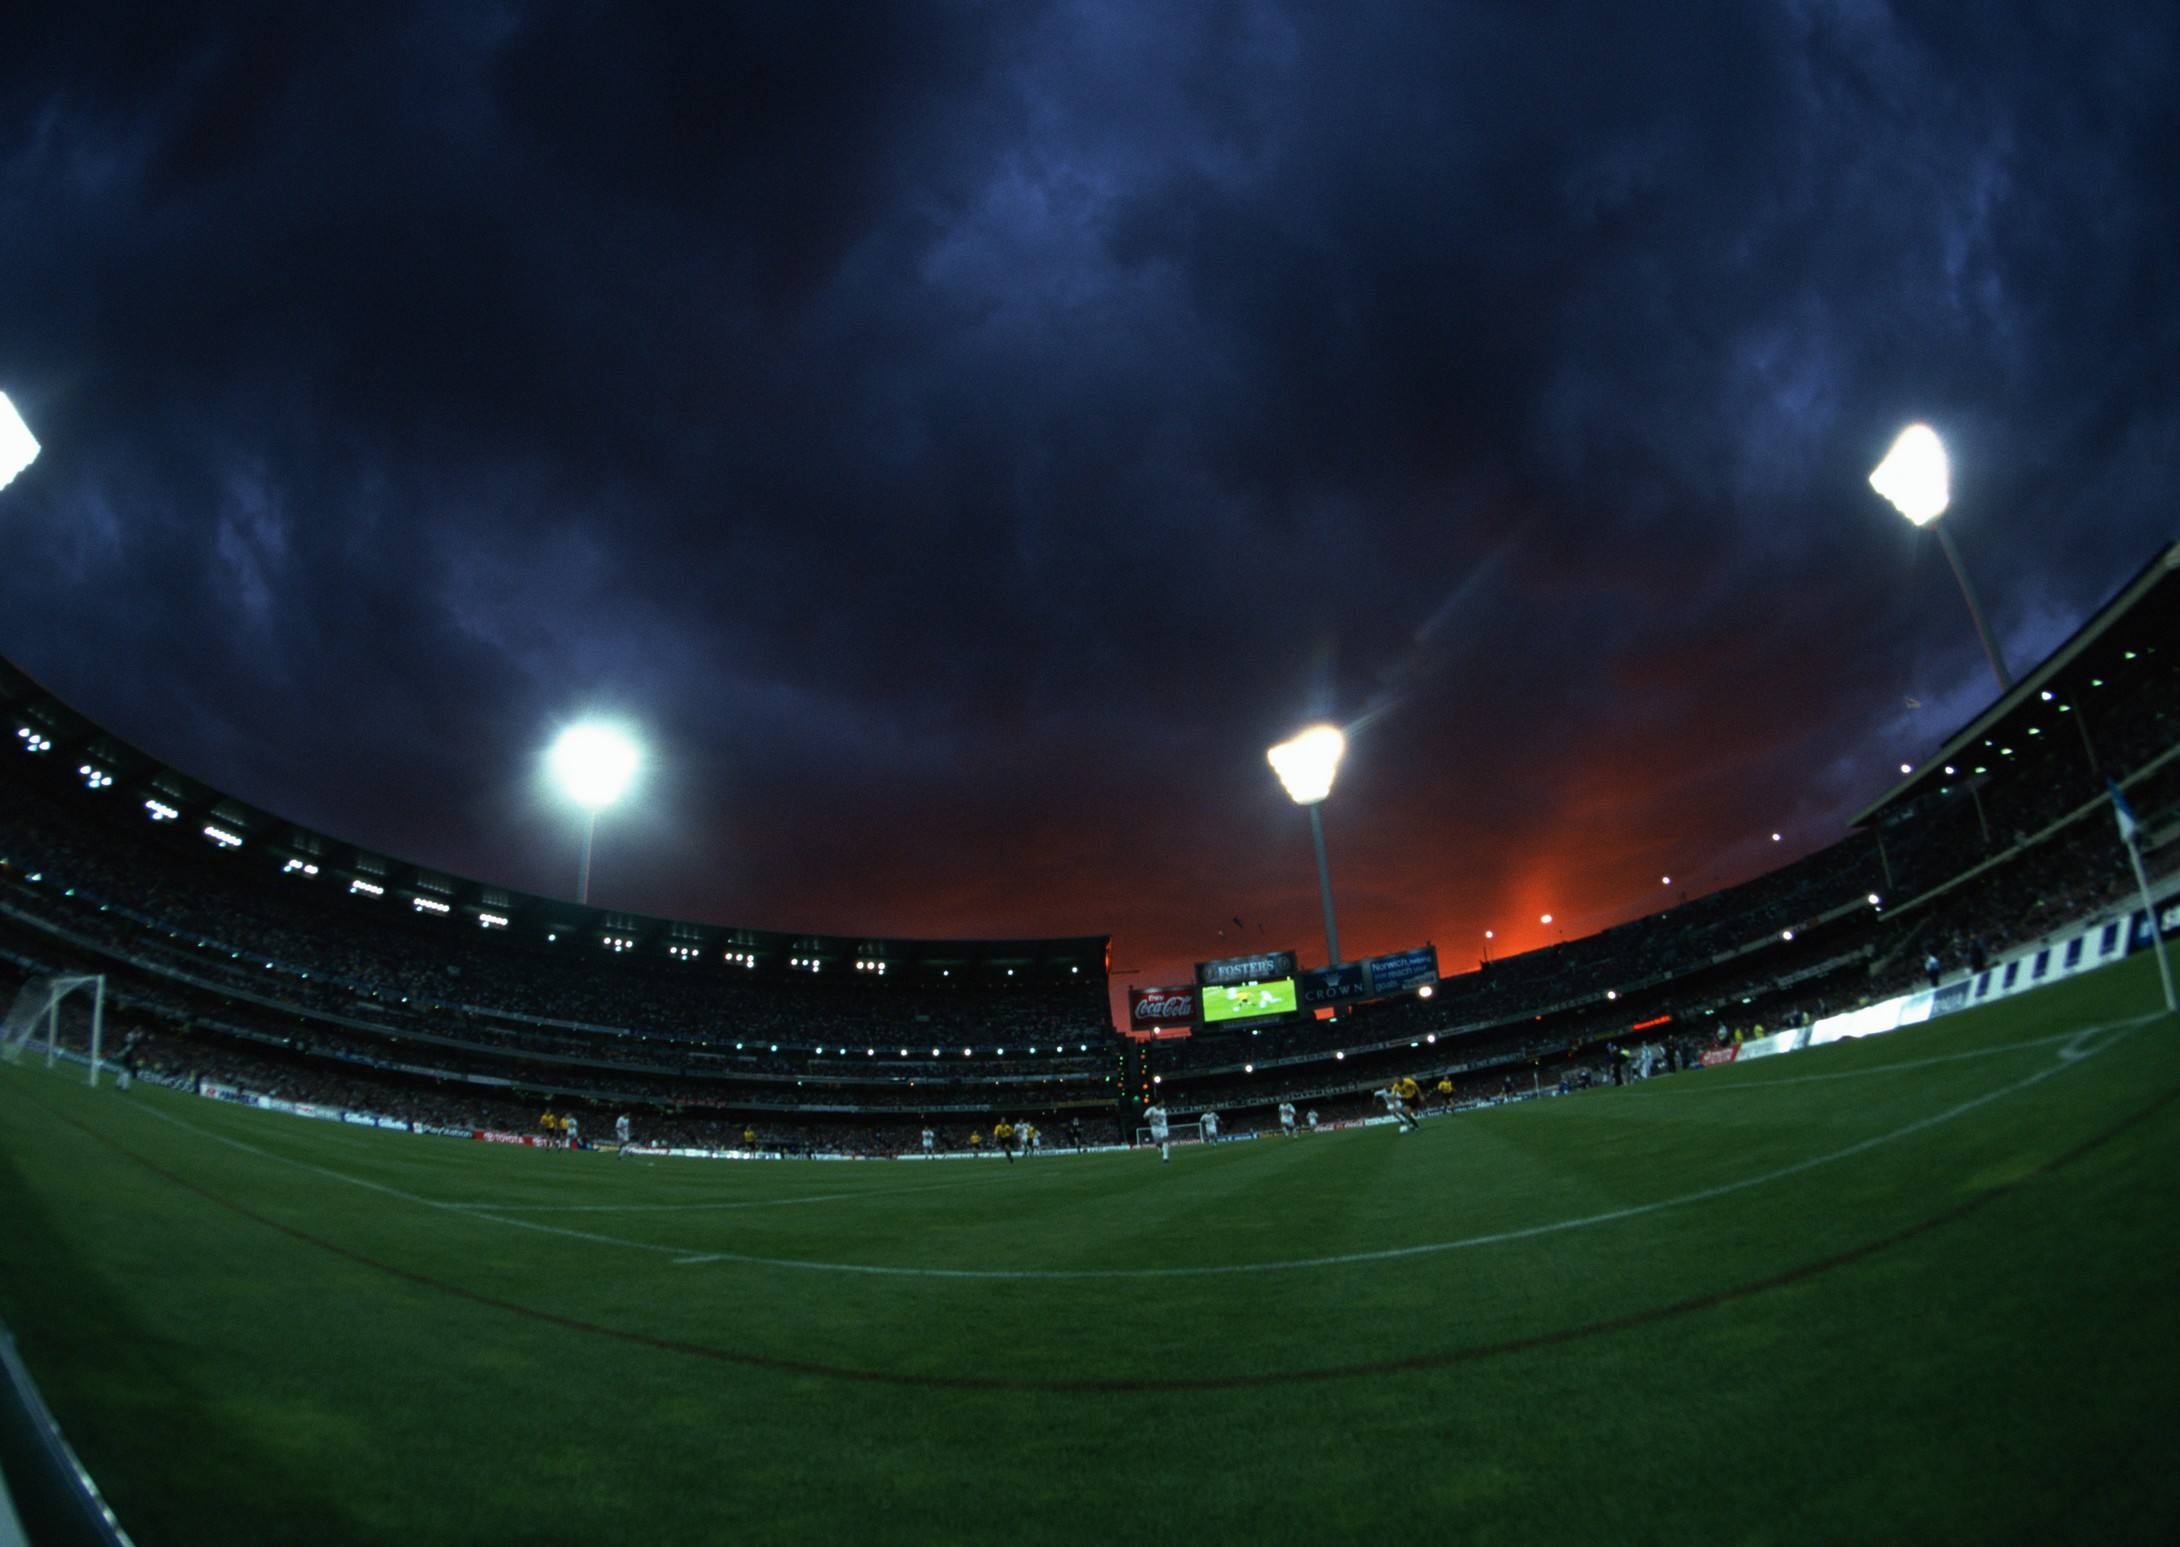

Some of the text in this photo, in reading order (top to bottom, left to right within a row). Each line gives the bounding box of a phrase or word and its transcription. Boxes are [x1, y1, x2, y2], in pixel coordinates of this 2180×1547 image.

[1218, 960, 1275, 978] FOSTER'S
[1304, 983, 1364, 1001] CROWN
[495, 1133, 524, 1144] TOYOTA
